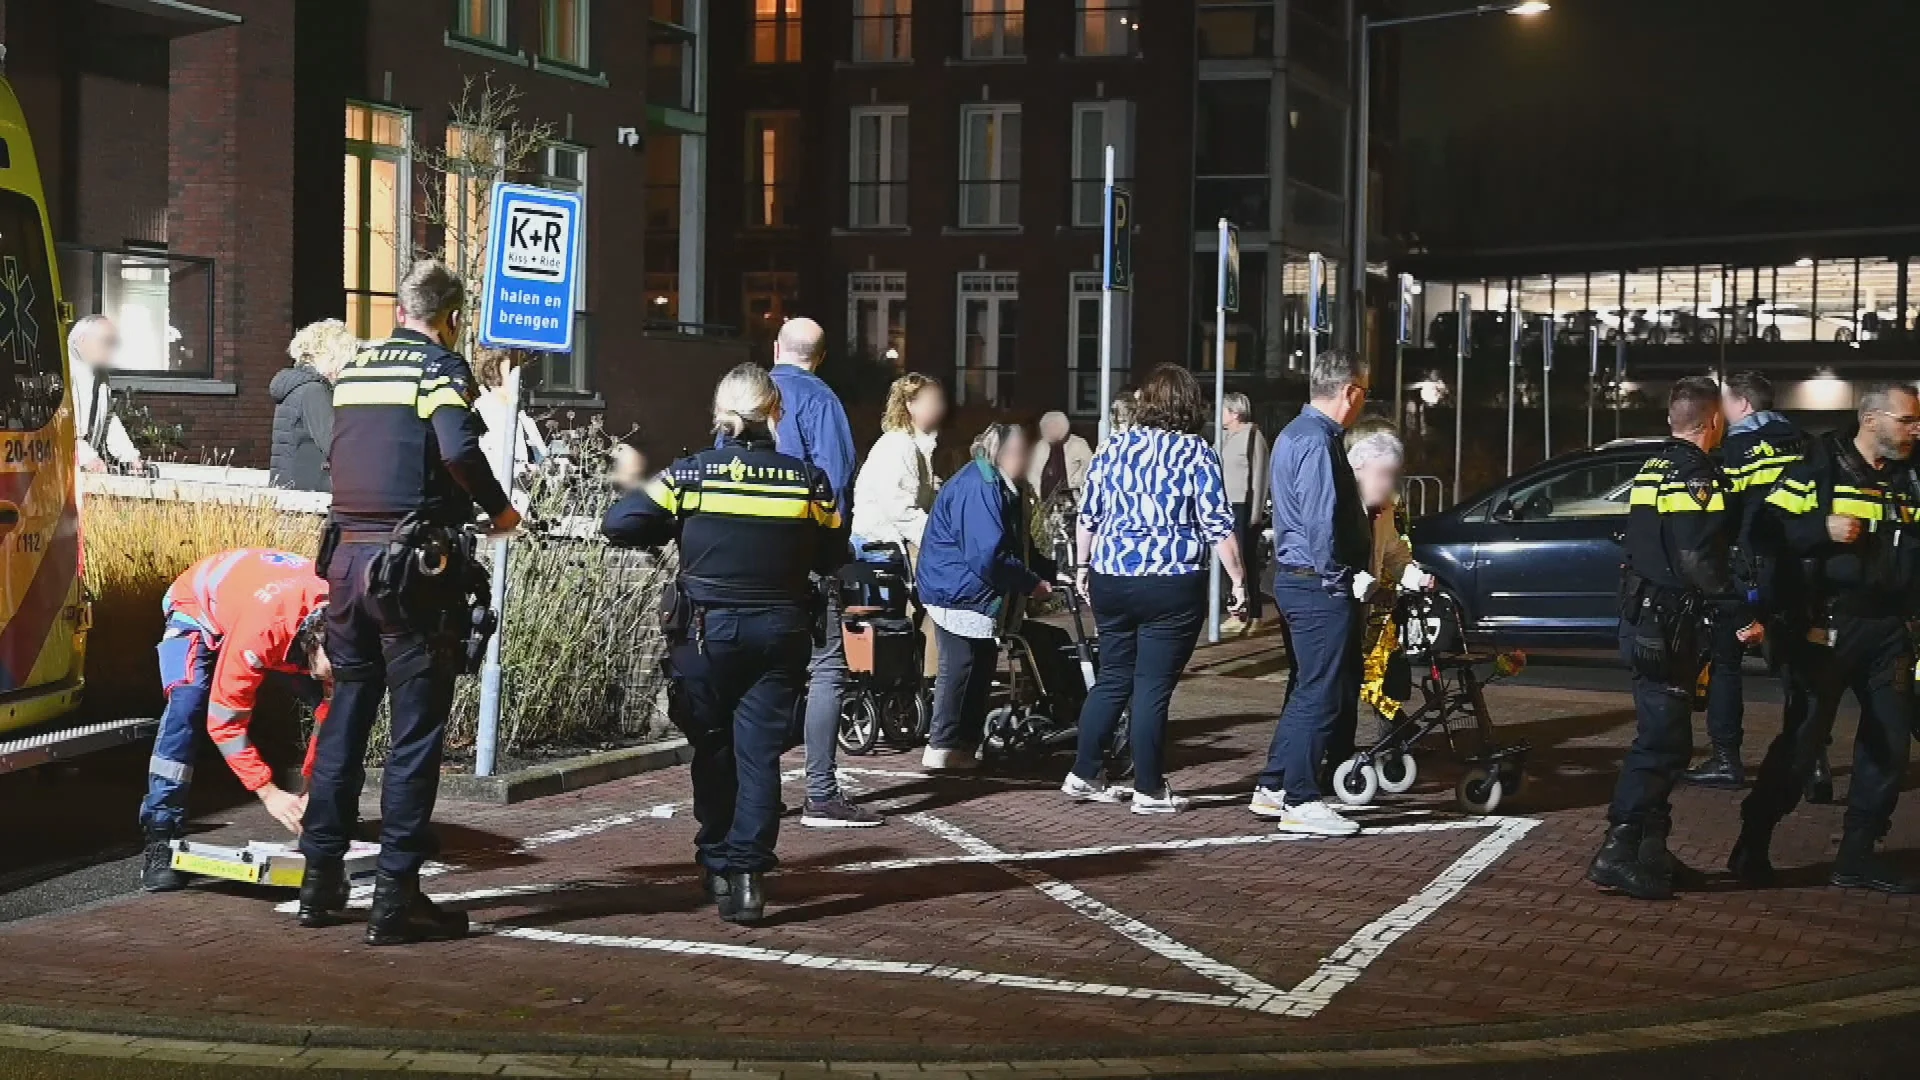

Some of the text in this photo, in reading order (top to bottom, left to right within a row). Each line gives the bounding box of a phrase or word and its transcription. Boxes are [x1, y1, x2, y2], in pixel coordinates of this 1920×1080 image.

[510, 216, 561, 254] K+R
[508, 252, 528, 264] Kiss
[540, 256, 561, 268] Ride
[500, 287, 561, 308] halen en
[499, 309, 559, 331] brengen
[5, 440, 51, 462] 20-184
